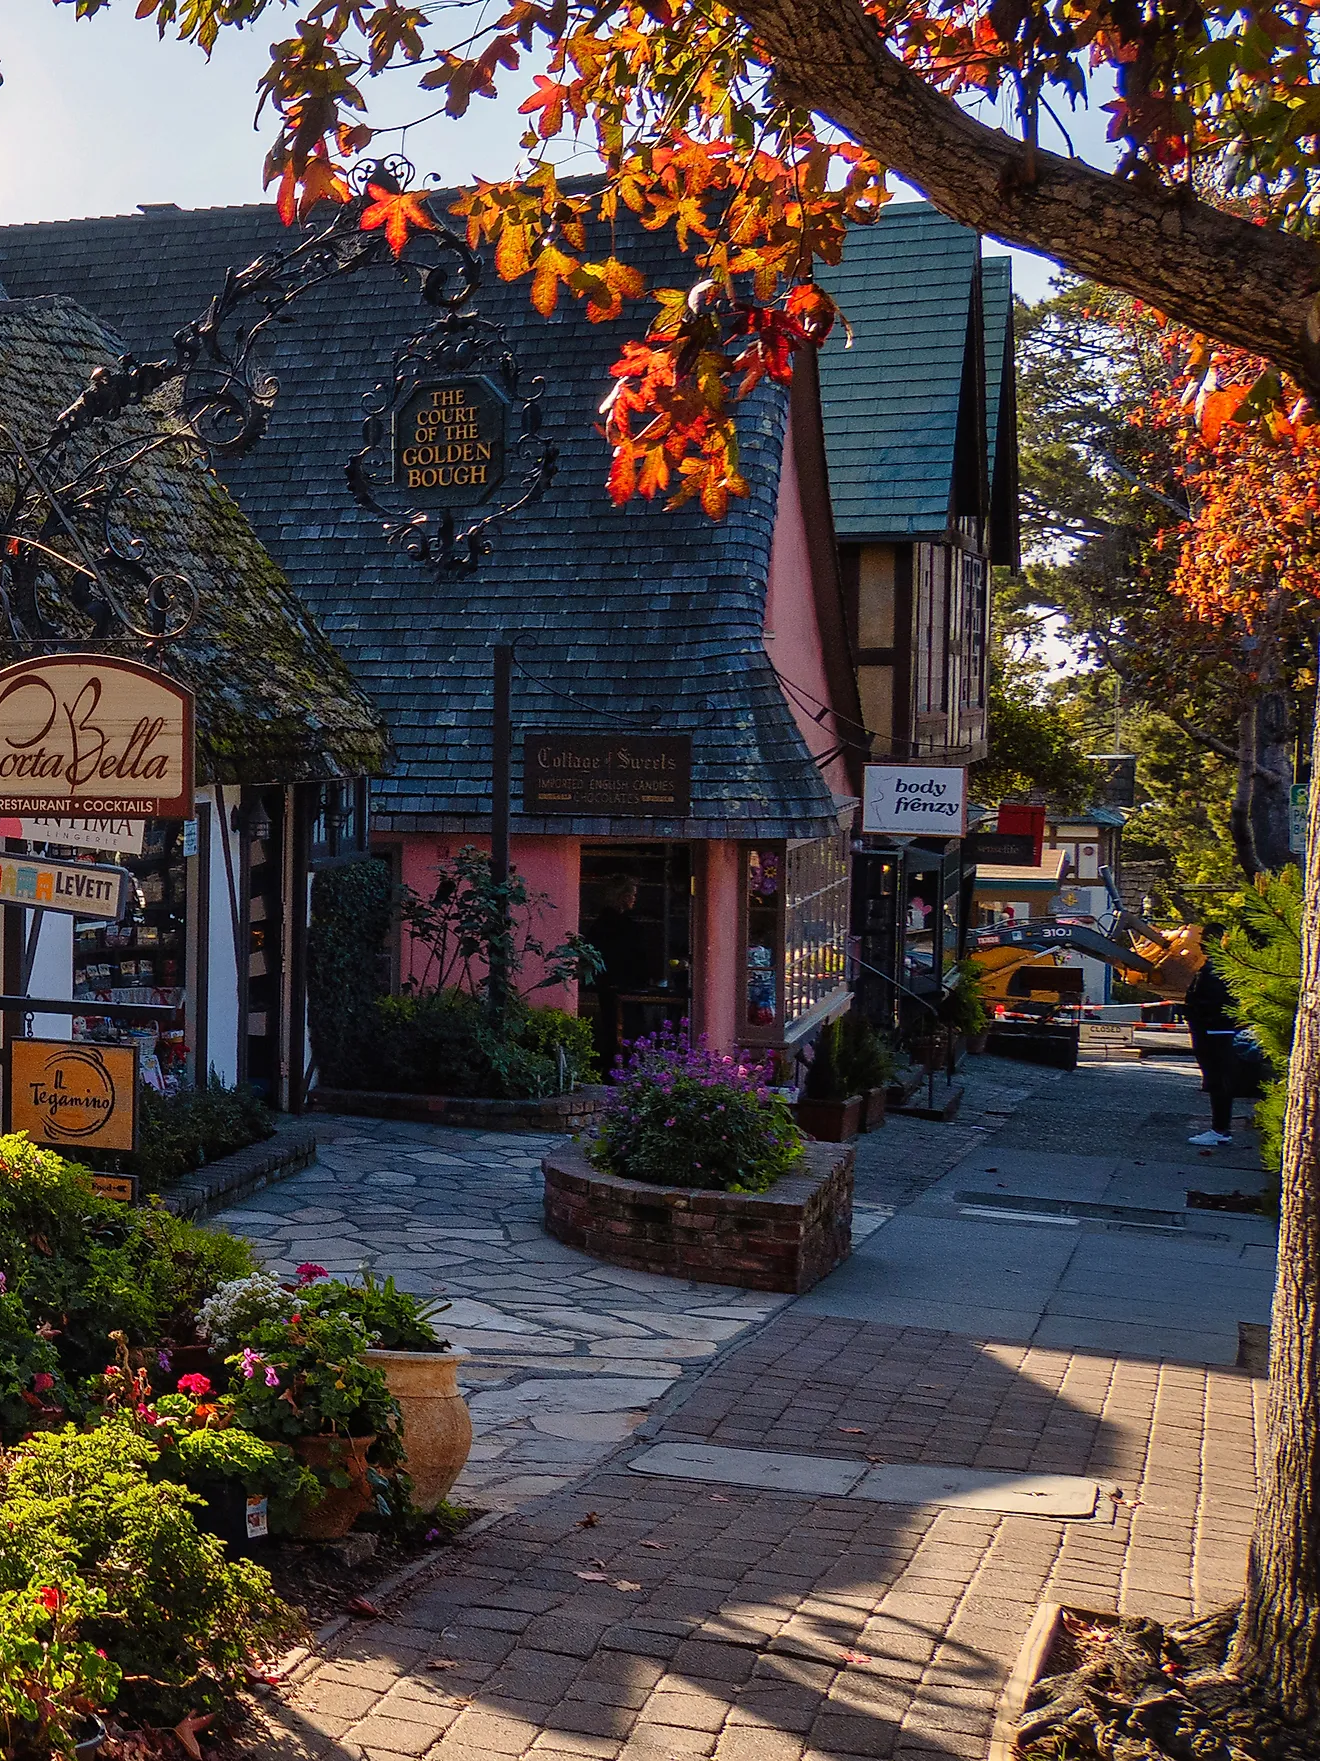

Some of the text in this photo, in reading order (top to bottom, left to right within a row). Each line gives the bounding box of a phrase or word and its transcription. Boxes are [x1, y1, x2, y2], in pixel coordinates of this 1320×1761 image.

[430, 390, 465, 406] THE
[417, 406, 478, 425] COURT
[415, 423, 479, 443] OF THE
[402, 442, 491, 466] GOLDEN
[407, 465, 487, 488] BOUGH
[616, 748, 676, 770] Sweets
[632, 780, 675, 791] CANDIES
[895, 778, 947, 797] body
[82, 800, 153, 813] COCKTAILS
[894, 796, 959, 816] frenzy
[46, 831, 118, 846] LINGERIE
[1042, 928, 1072, 938] 310J
[1090, 1025, 1121, 1033] CLOSED
[30, 1082, 110, 1115] Tegamino
